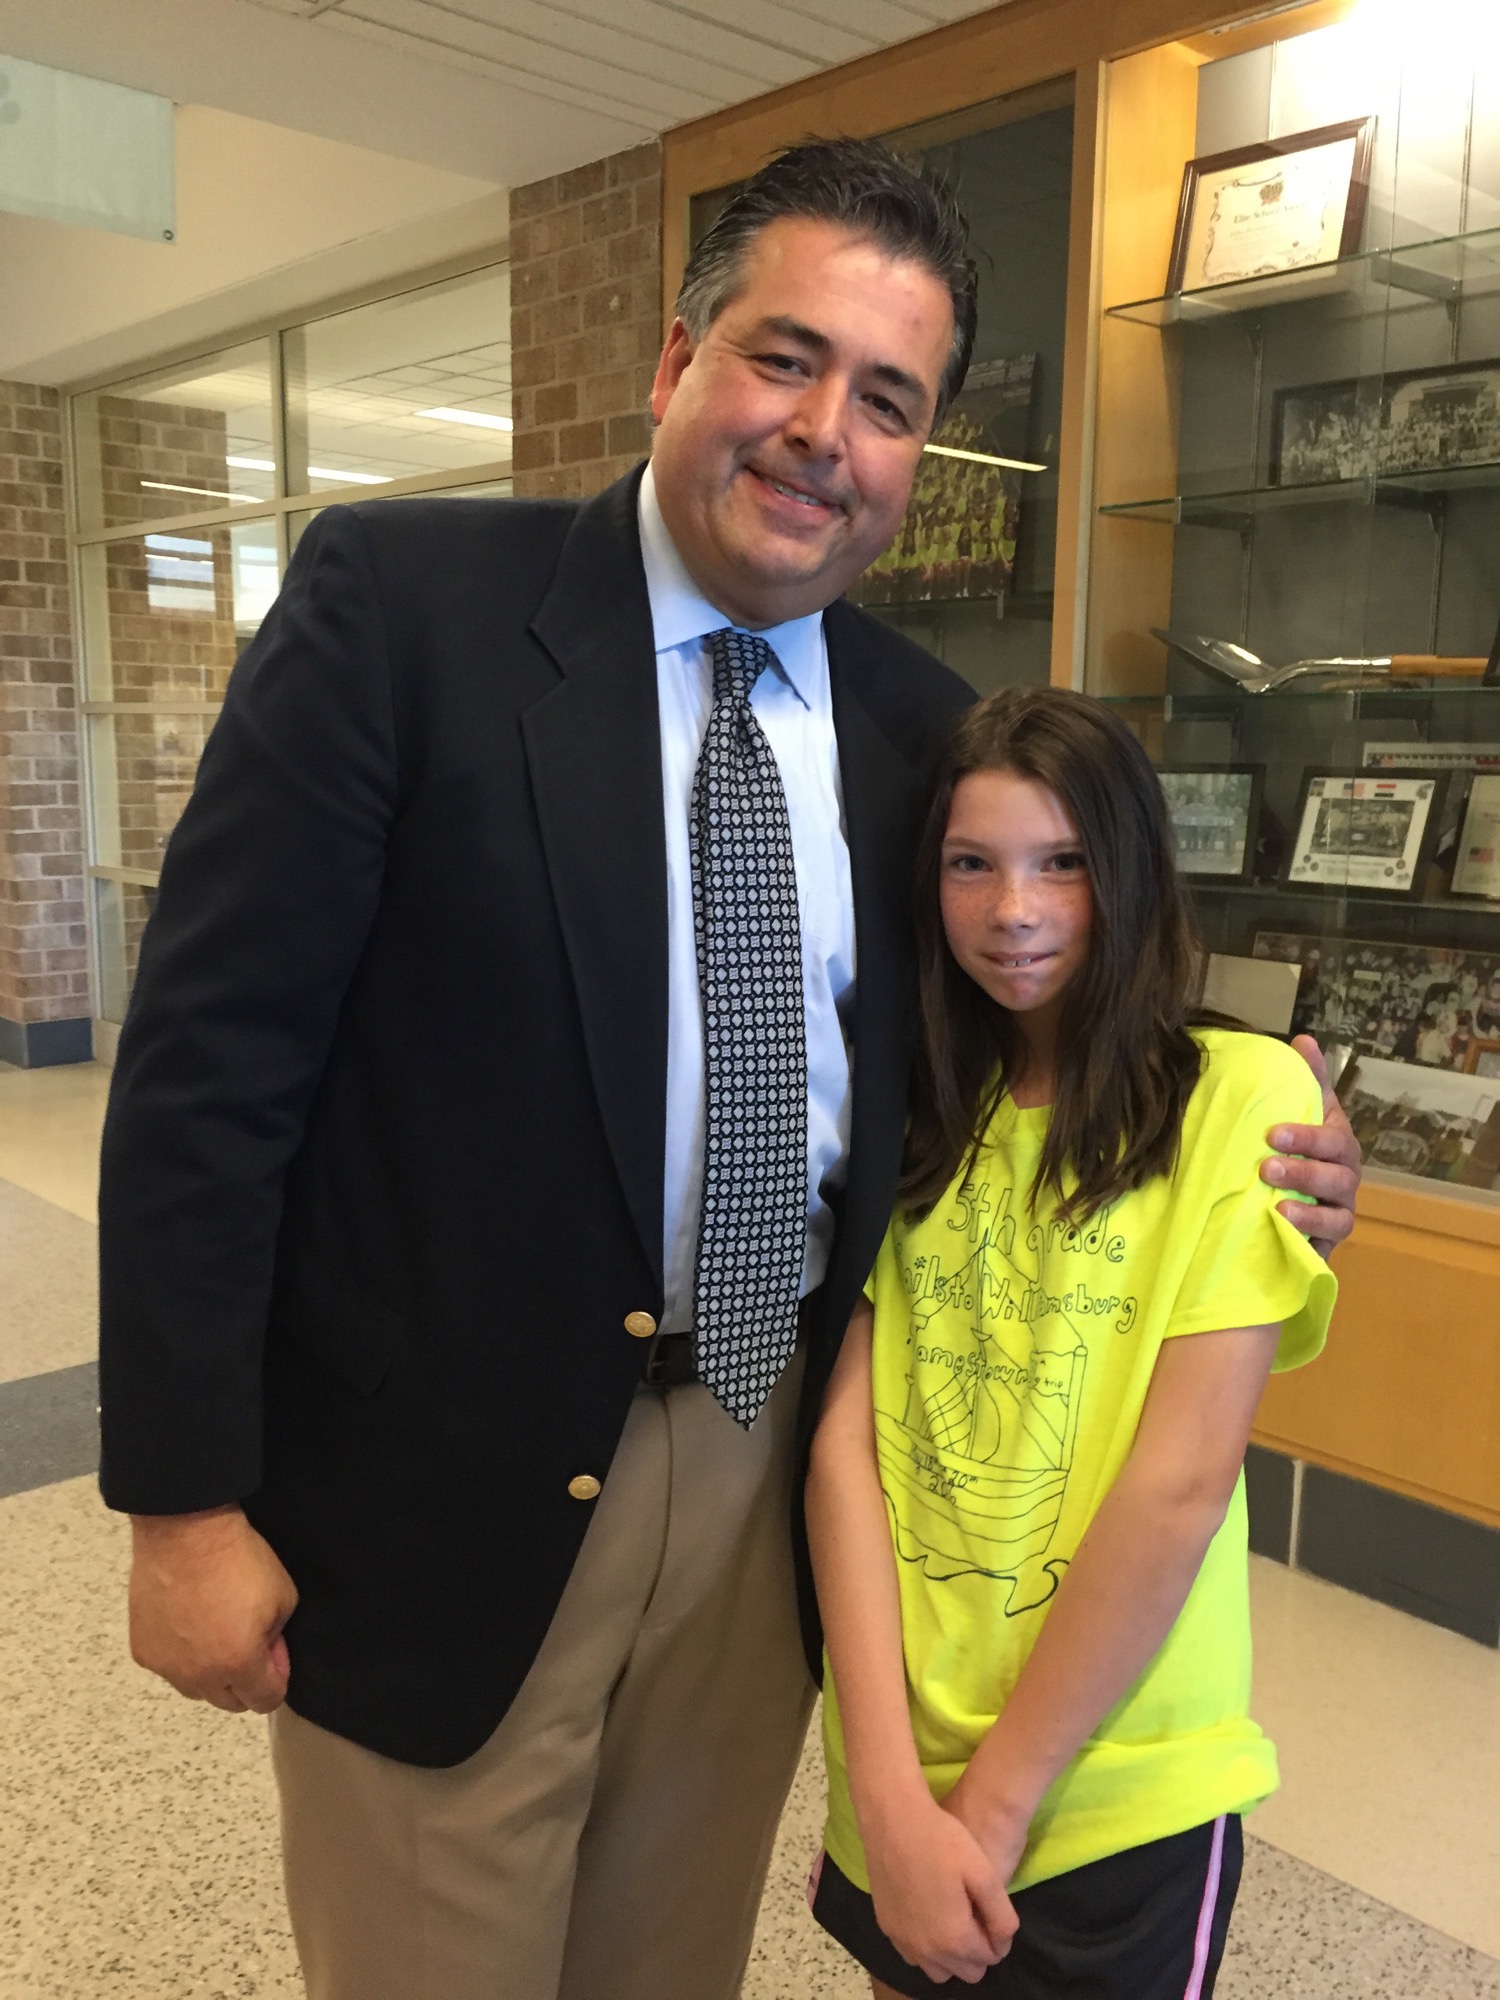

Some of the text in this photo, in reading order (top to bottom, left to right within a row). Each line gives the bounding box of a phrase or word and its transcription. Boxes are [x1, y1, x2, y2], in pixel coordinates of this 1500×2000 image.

[896, 1244, 948, 1303] ails
[947, 1183, 1126, 1293] 5th grade
